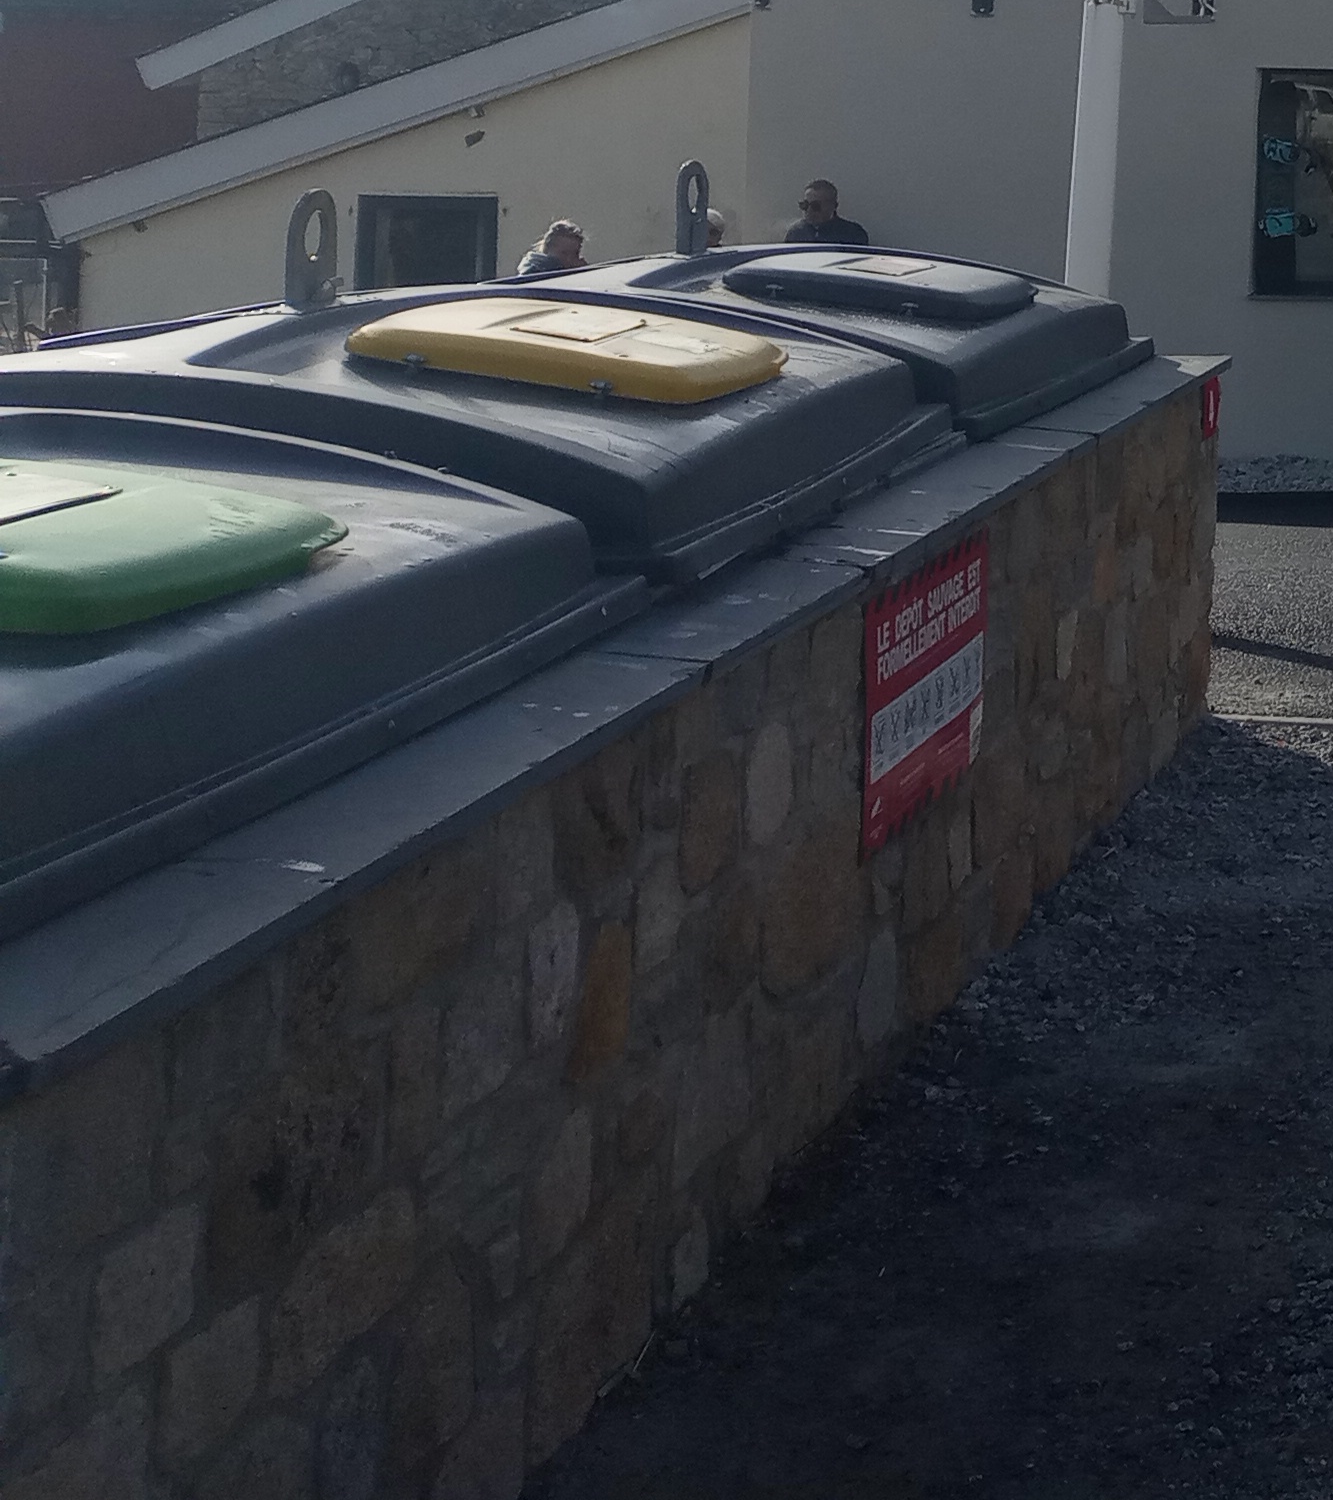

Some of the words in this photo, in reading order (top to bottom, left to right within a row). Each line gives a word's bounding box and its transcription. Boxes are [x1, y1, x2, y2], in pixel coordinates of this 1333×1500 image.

[877, 620, 890, 654] LE
[895, 597, 923, 643] DÉPÔT
[927, 571, 965, 619] SAUVAGE
[967, 558, 982, 591] EST
[877, 611, 946, 685] FORMELLEMENT
[948, 586, 981, 633] INTERDIT
